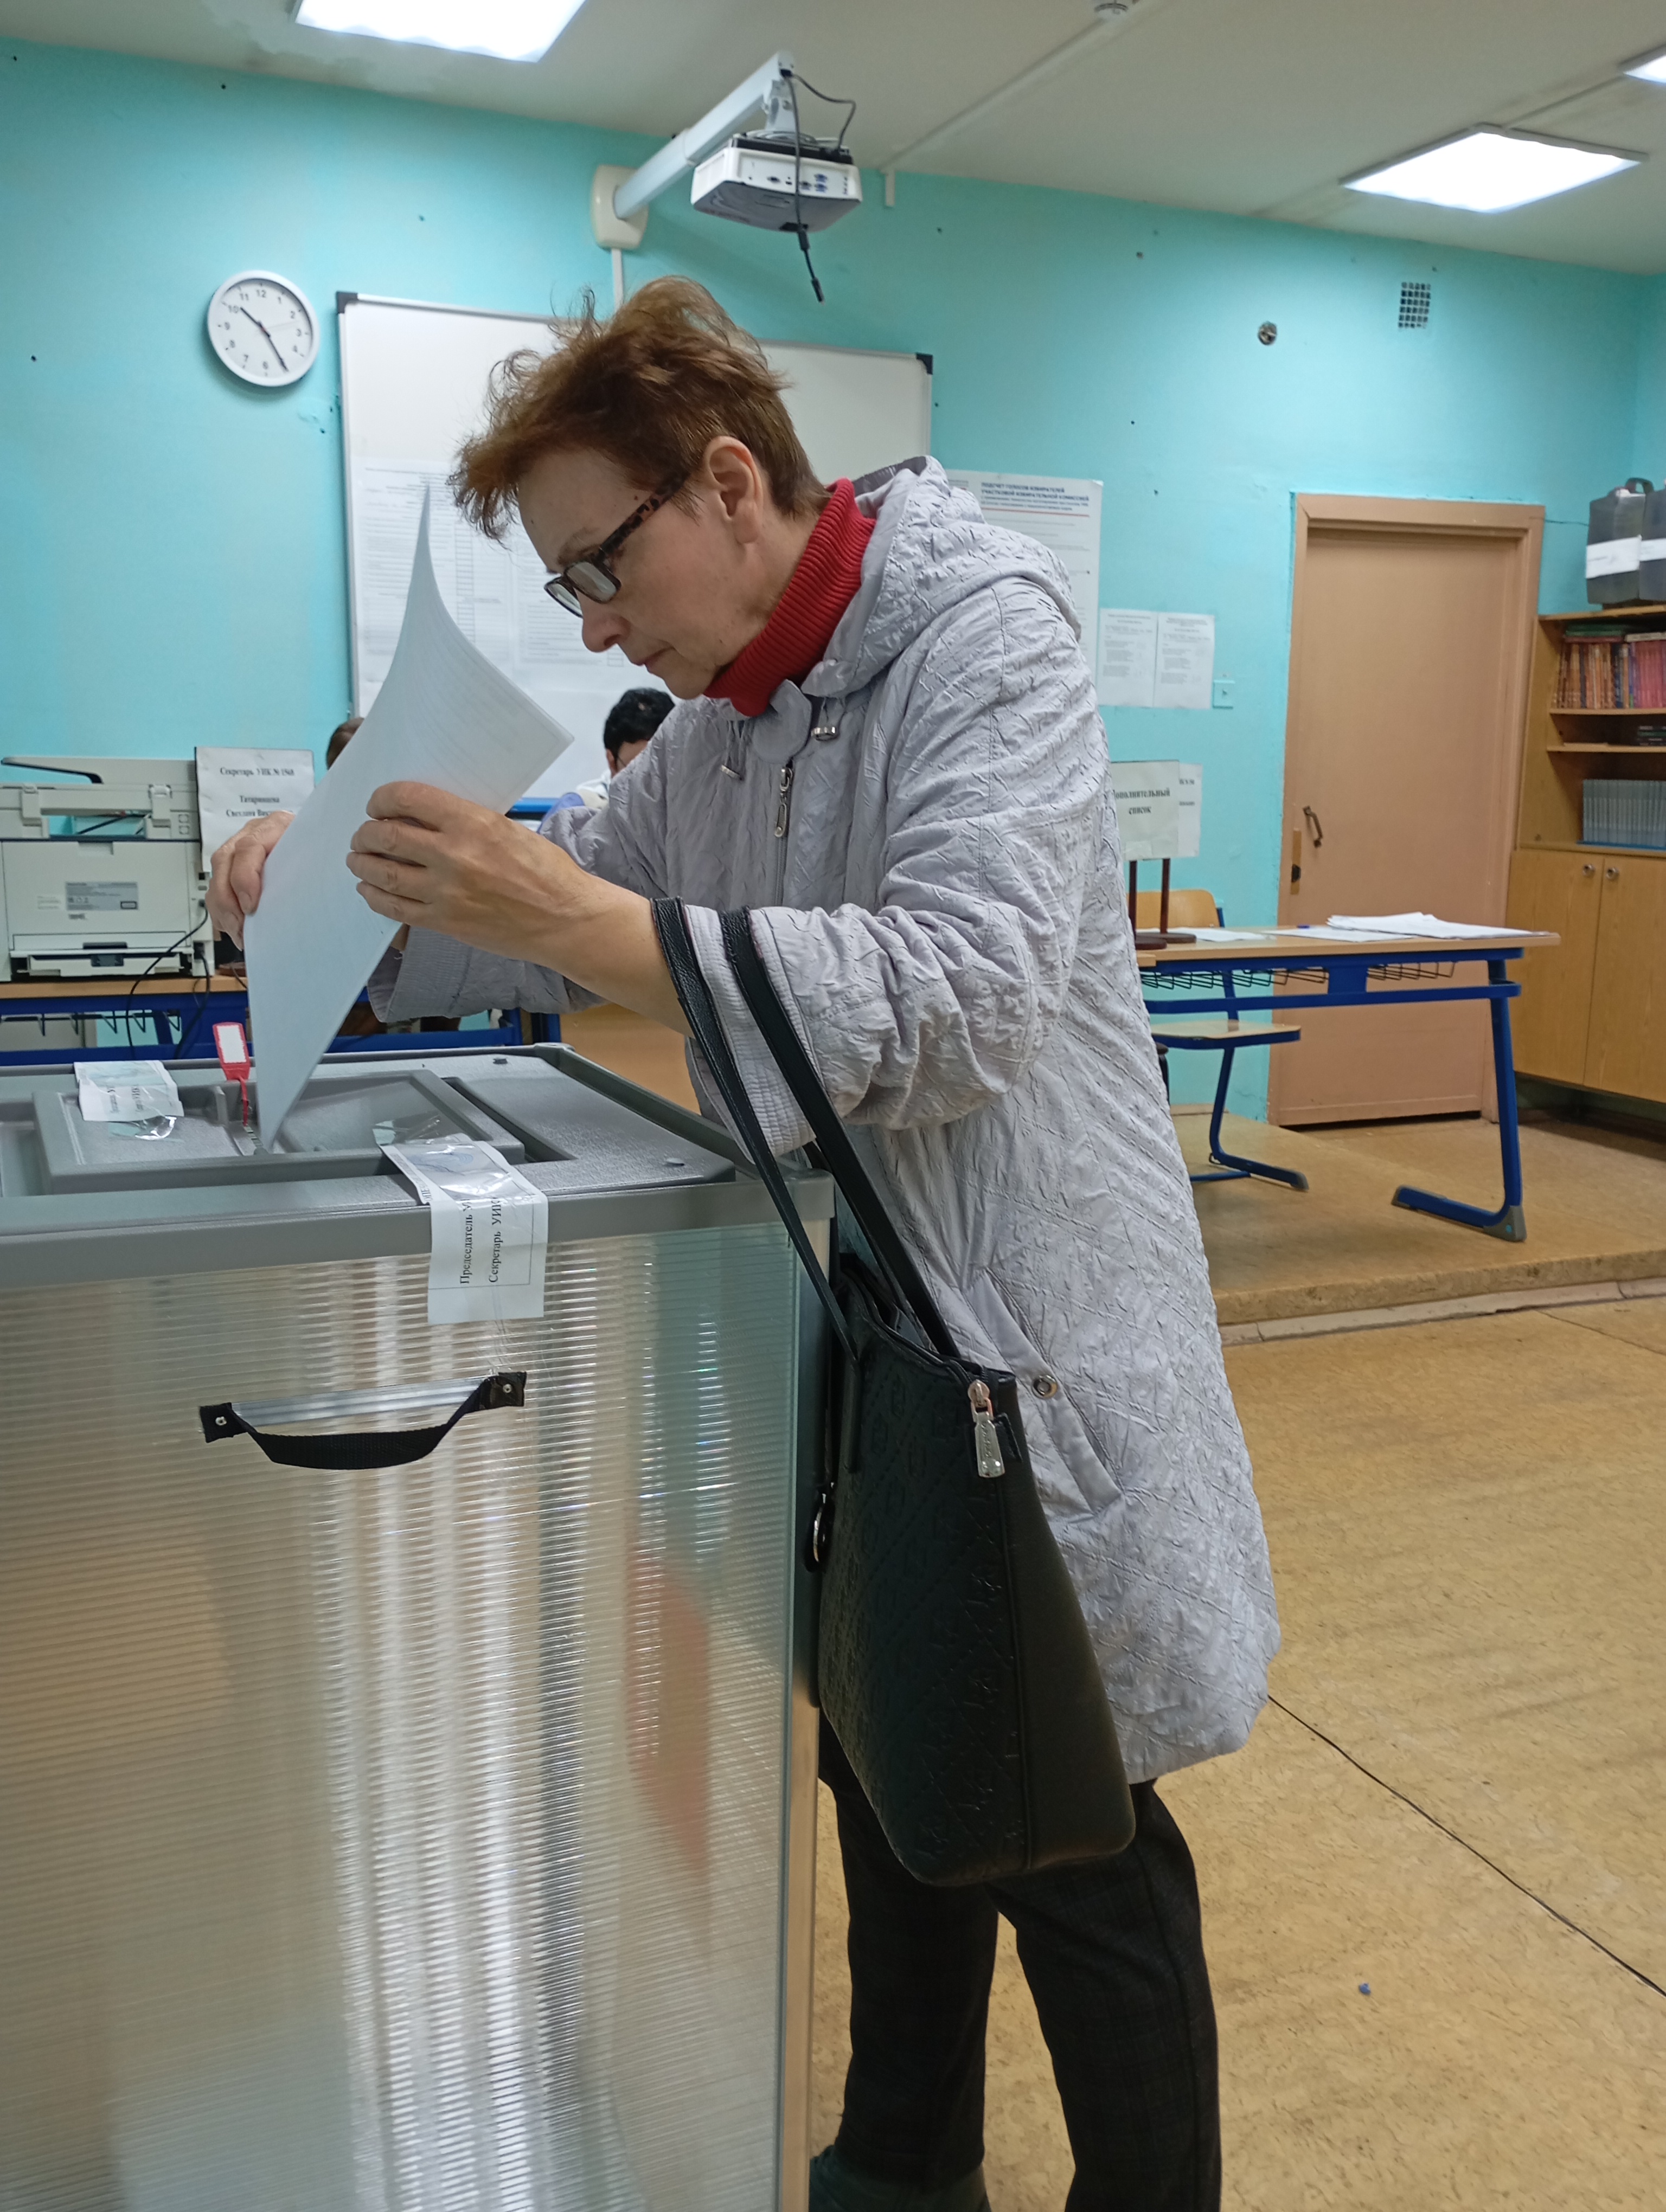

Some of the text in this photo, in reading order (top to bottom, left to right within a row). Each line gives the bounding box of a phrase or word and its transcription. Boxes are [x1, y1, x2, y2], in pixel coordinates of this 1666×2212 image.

[256, 290, 266, 298] 12
[228, 305, 239, 314] 10
[290, 311, 296, 319] 2
[224, 321, 230, 330] 9
[296, 328, 302, 337] 3
[244, 353, 249, 362] 7
[262, 361, 268, 370] 6
[220, 767, 254, 777] Секретарь
[1129, 806, 1151, 815] список
[460, 1214, 473, 1284] Председатель
[489, 1231, 503, 1283] Секретарь
